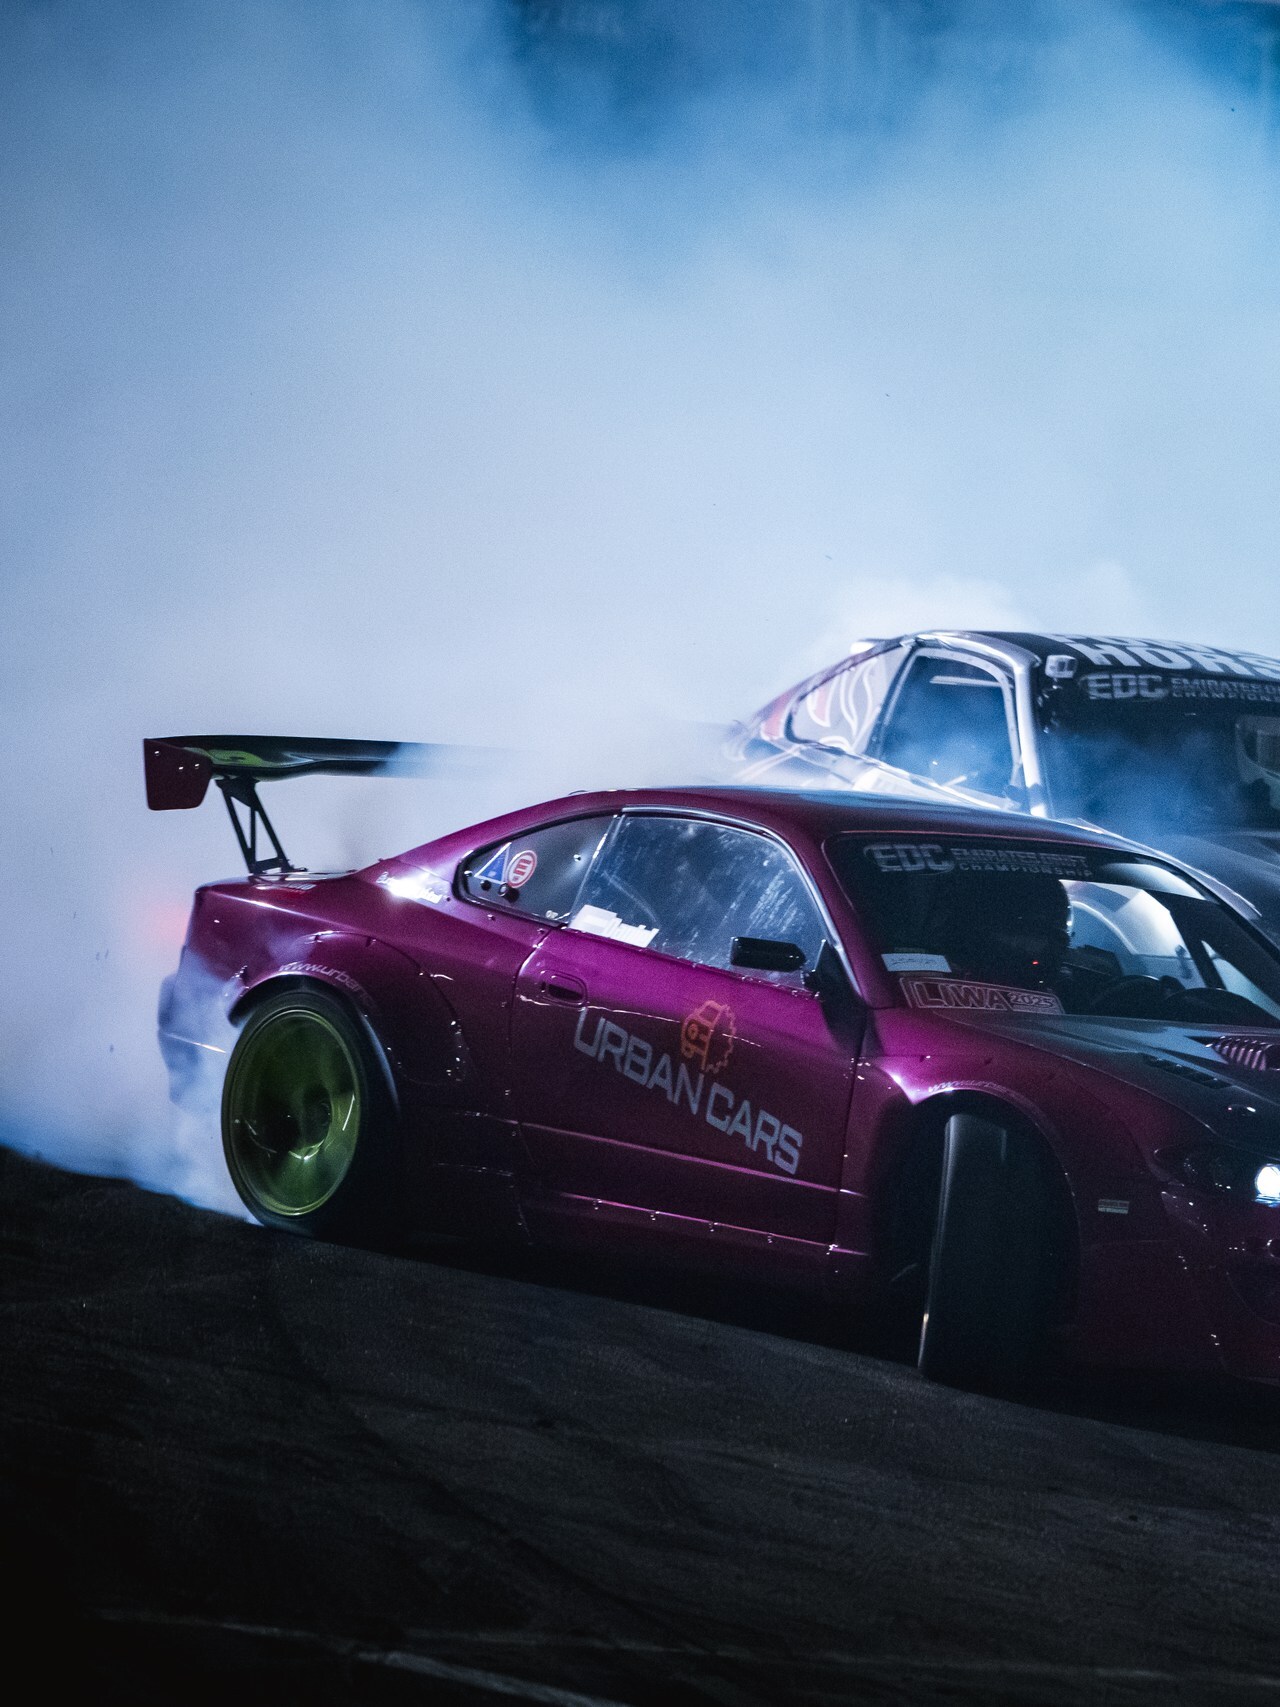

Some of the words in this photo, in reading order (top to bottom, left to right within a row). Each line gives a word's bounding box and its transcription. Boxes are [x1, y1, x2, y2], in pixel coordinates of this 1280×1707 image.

[1085, 673, 1170, 700] EDC
[870, 843, 951, 873] EDC
[912, 981, 1009, 1011] LIWA
[1007, 991, 1055, 1009] 2025
[573, 1006, 705, 1116] URBAN
[705, 1081, 804, 1175] CARS
